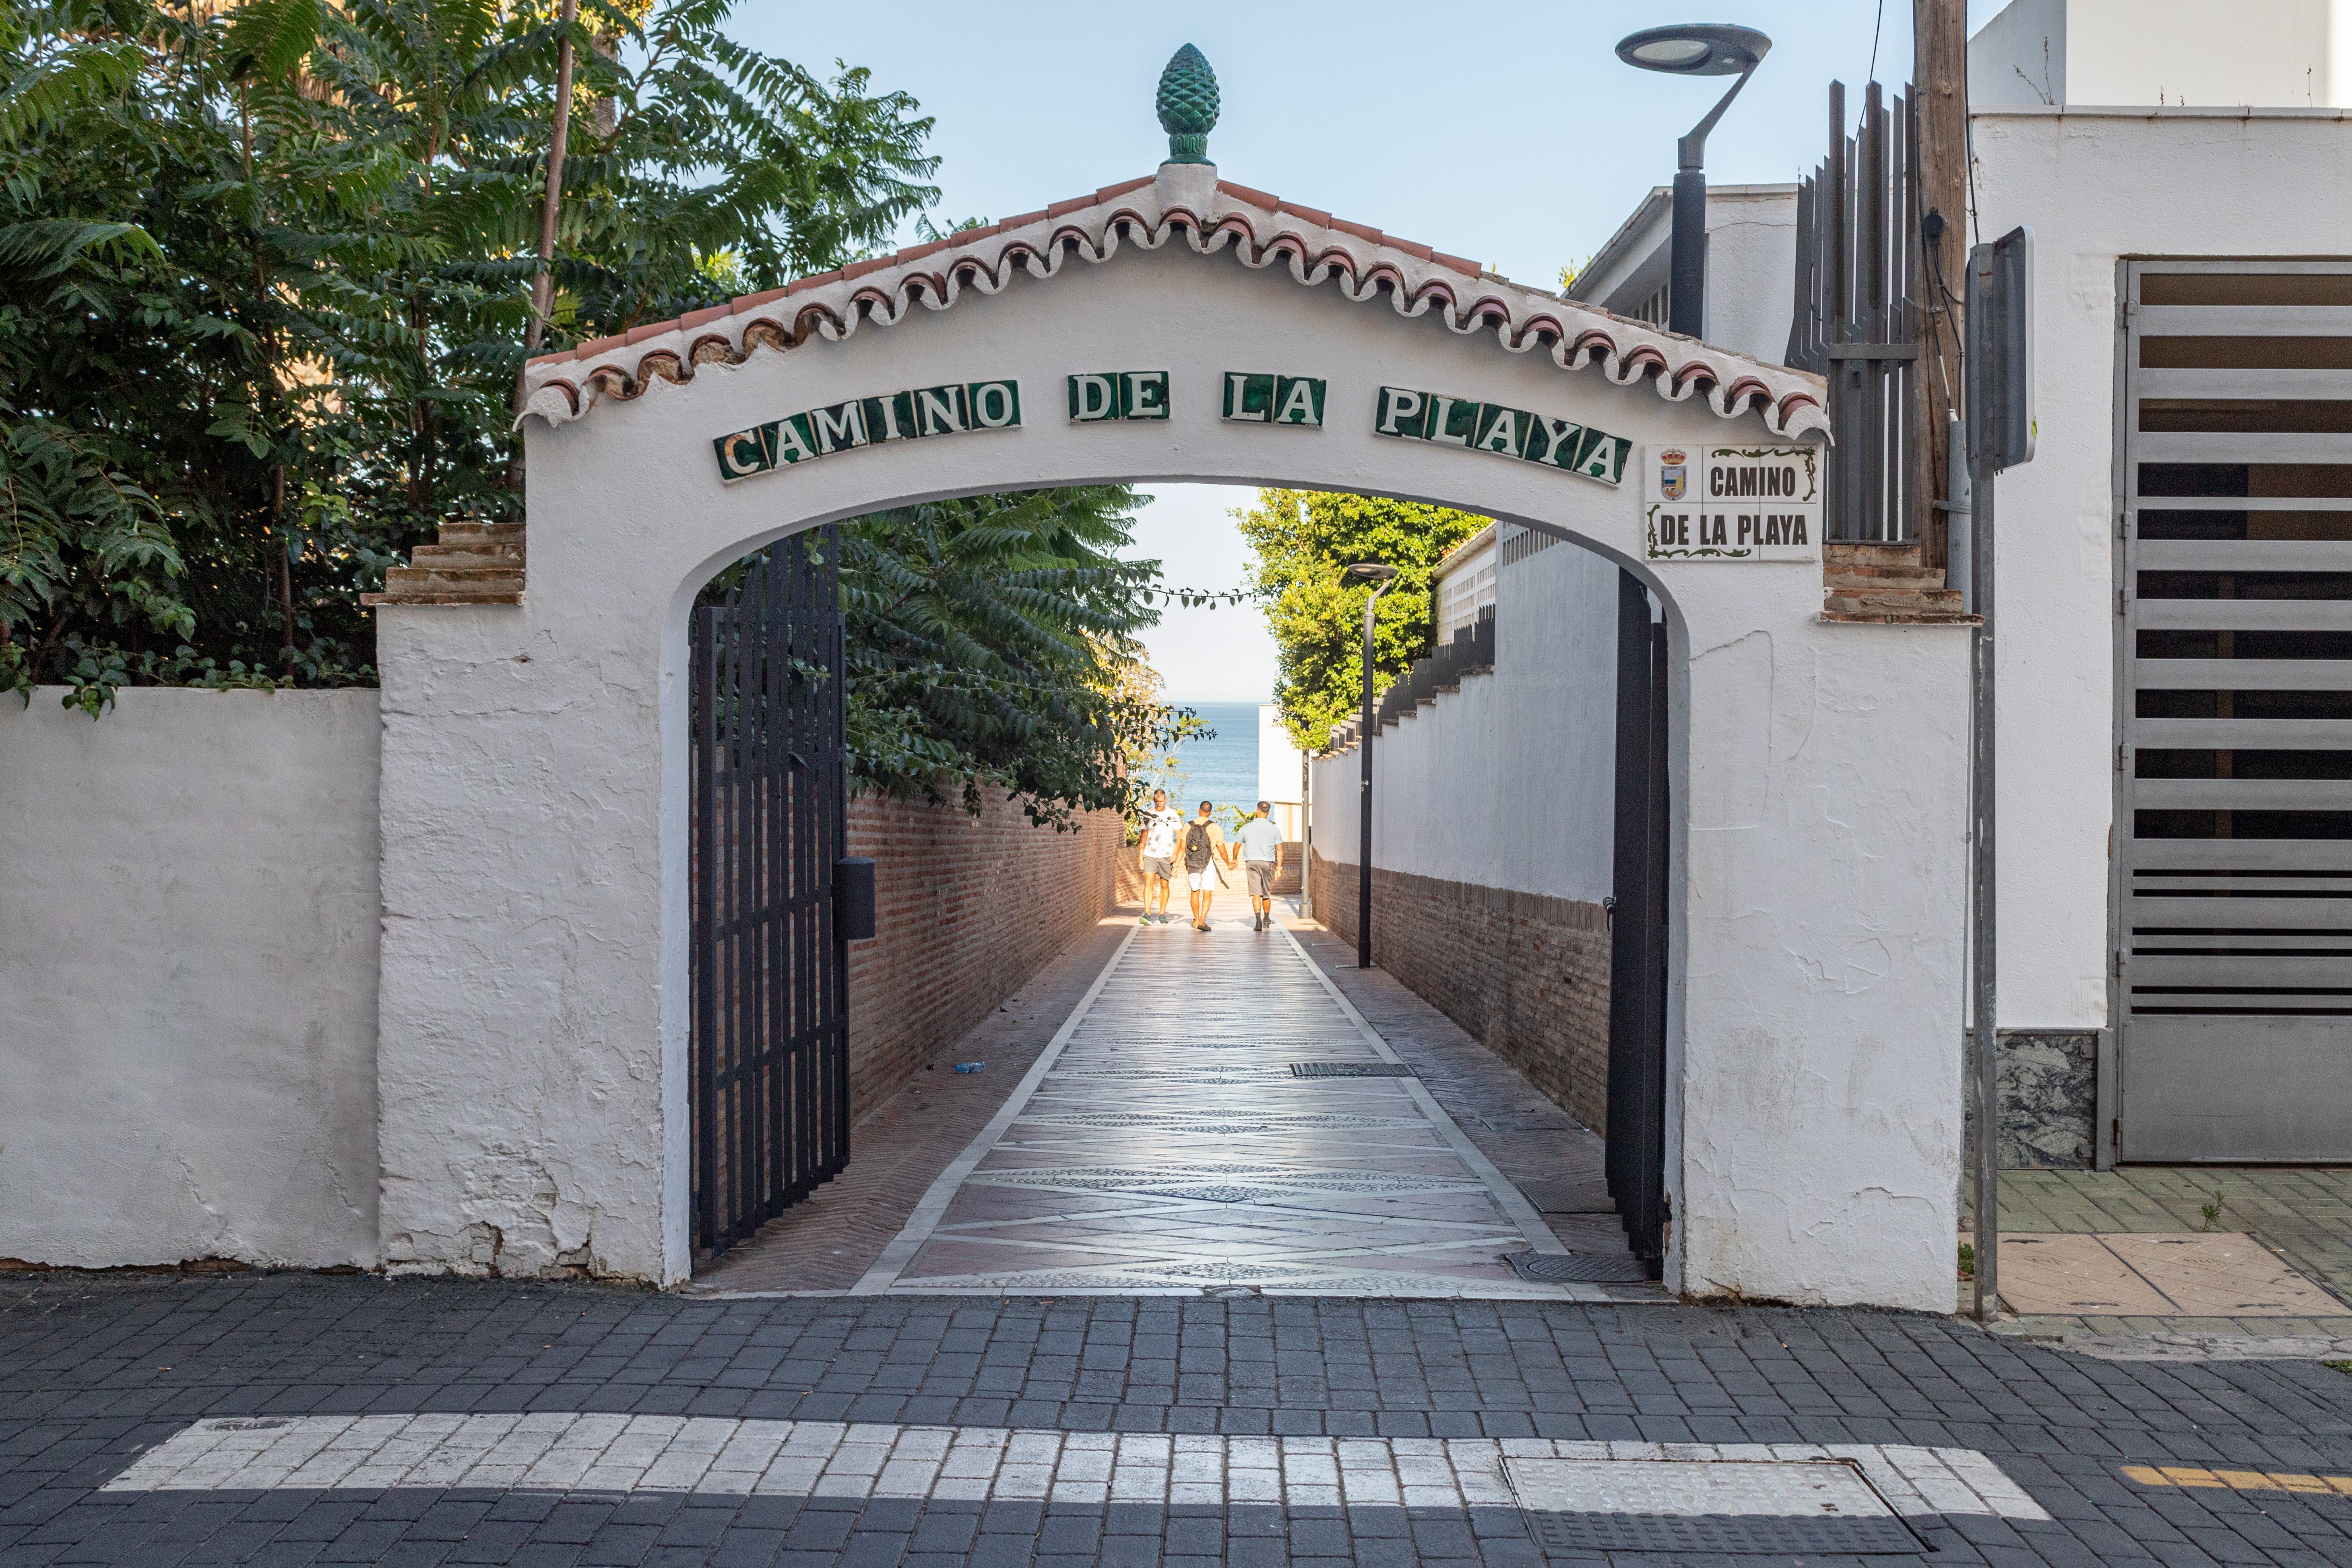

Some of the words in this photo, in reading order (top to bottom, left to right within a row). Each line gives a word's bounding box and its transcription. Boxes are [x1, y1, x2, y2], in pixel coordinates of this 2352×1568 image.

[725, 383, 1013, 475] CAMINO
[1073, 373, 1163, 419] DE
[1230, 375, 1319, 425] LA
[1384, 388, 1617, 484] PLAYA
[1710, 466, 1796, 497] CAMINO
[1661, 515, 1689, 545] DE
[1700, 515, 1727, 545] LA
[1737, 515, 1808, 545] PLAYA
